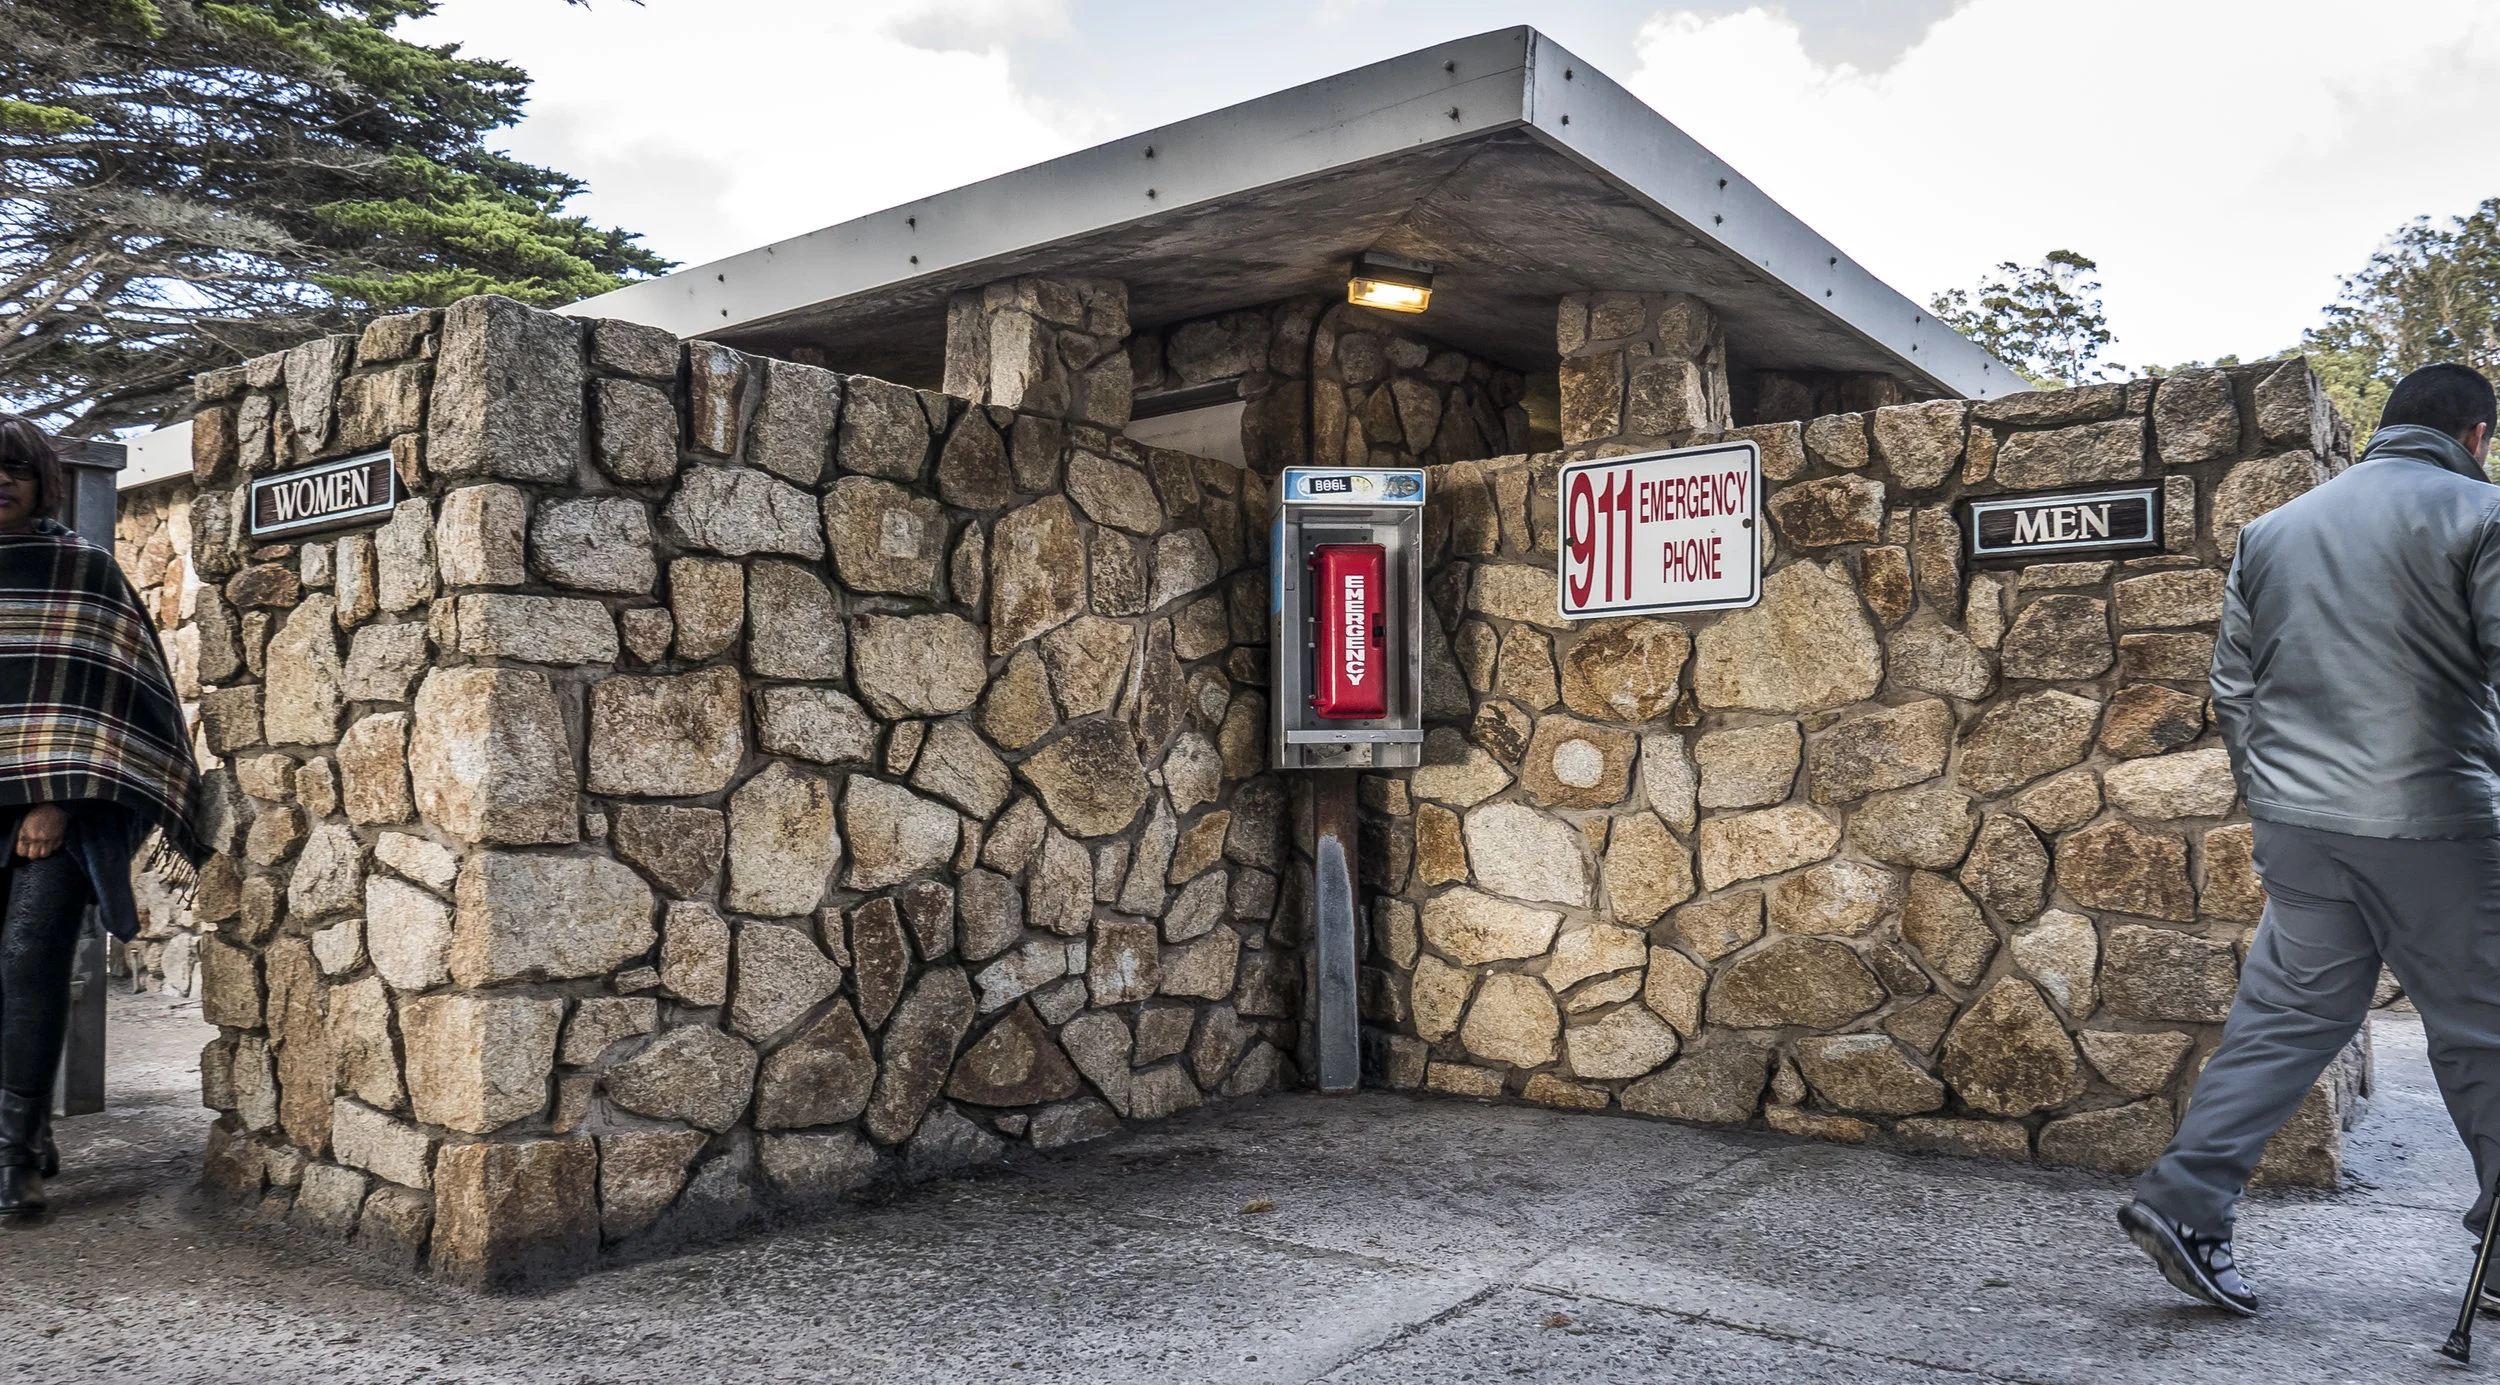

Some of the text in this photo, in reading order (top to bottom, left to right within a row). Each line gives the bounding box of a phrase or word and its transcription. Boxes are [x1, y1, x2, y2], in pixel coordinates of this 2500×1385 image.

[272, 466, 371, 521] WOMEN
[1569, 469, 1748, 608] 911 EMERGENCY
[2011, 503, 2111, 544] MEN
[1663, 537, 1722, 583] PHONE
[1344, 575, 1365, 686] EMERGENCY
